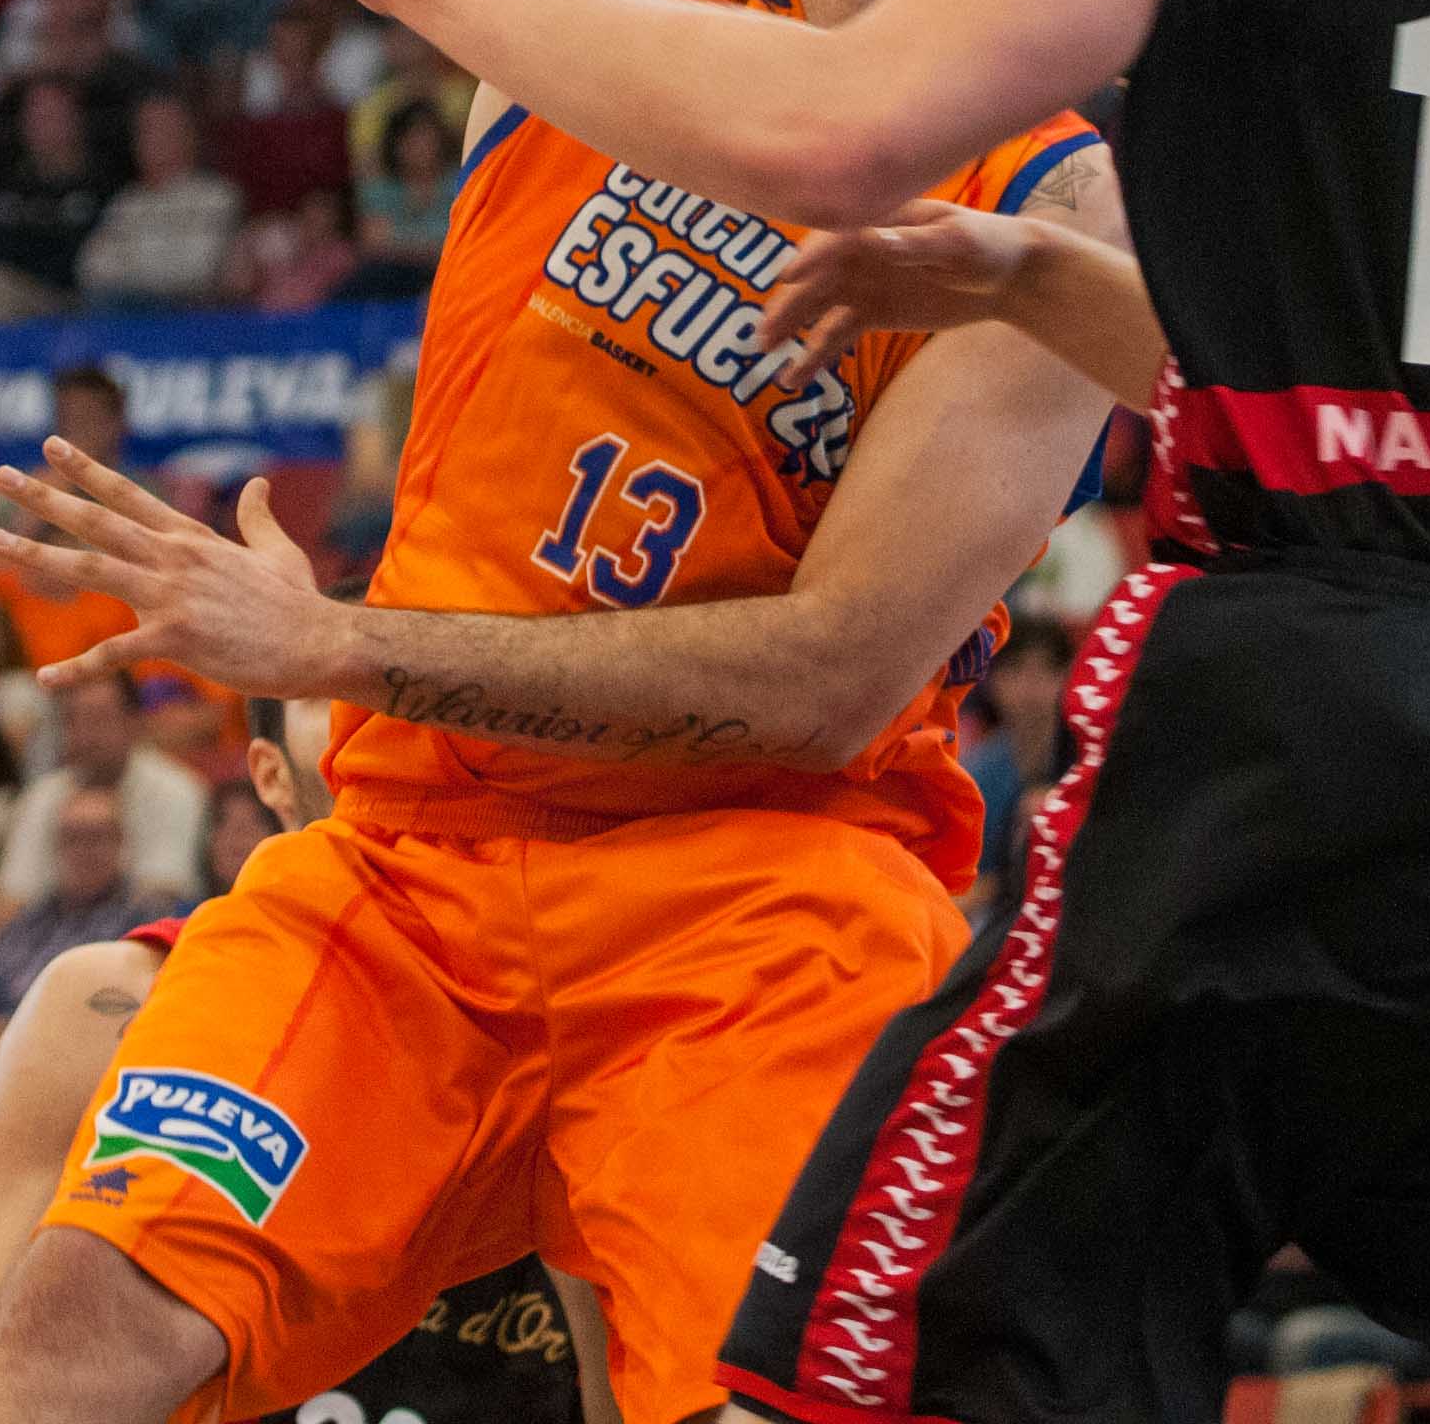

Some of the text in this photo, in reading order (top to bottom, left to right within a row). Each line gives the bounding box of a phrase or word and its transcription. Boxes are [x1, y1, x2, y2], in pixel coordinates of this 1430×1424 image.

[590, 331, 659, 378] BASKET
[532, 431, 708, 610] 13
[119, 1077, 289, 1169] PULEVA
